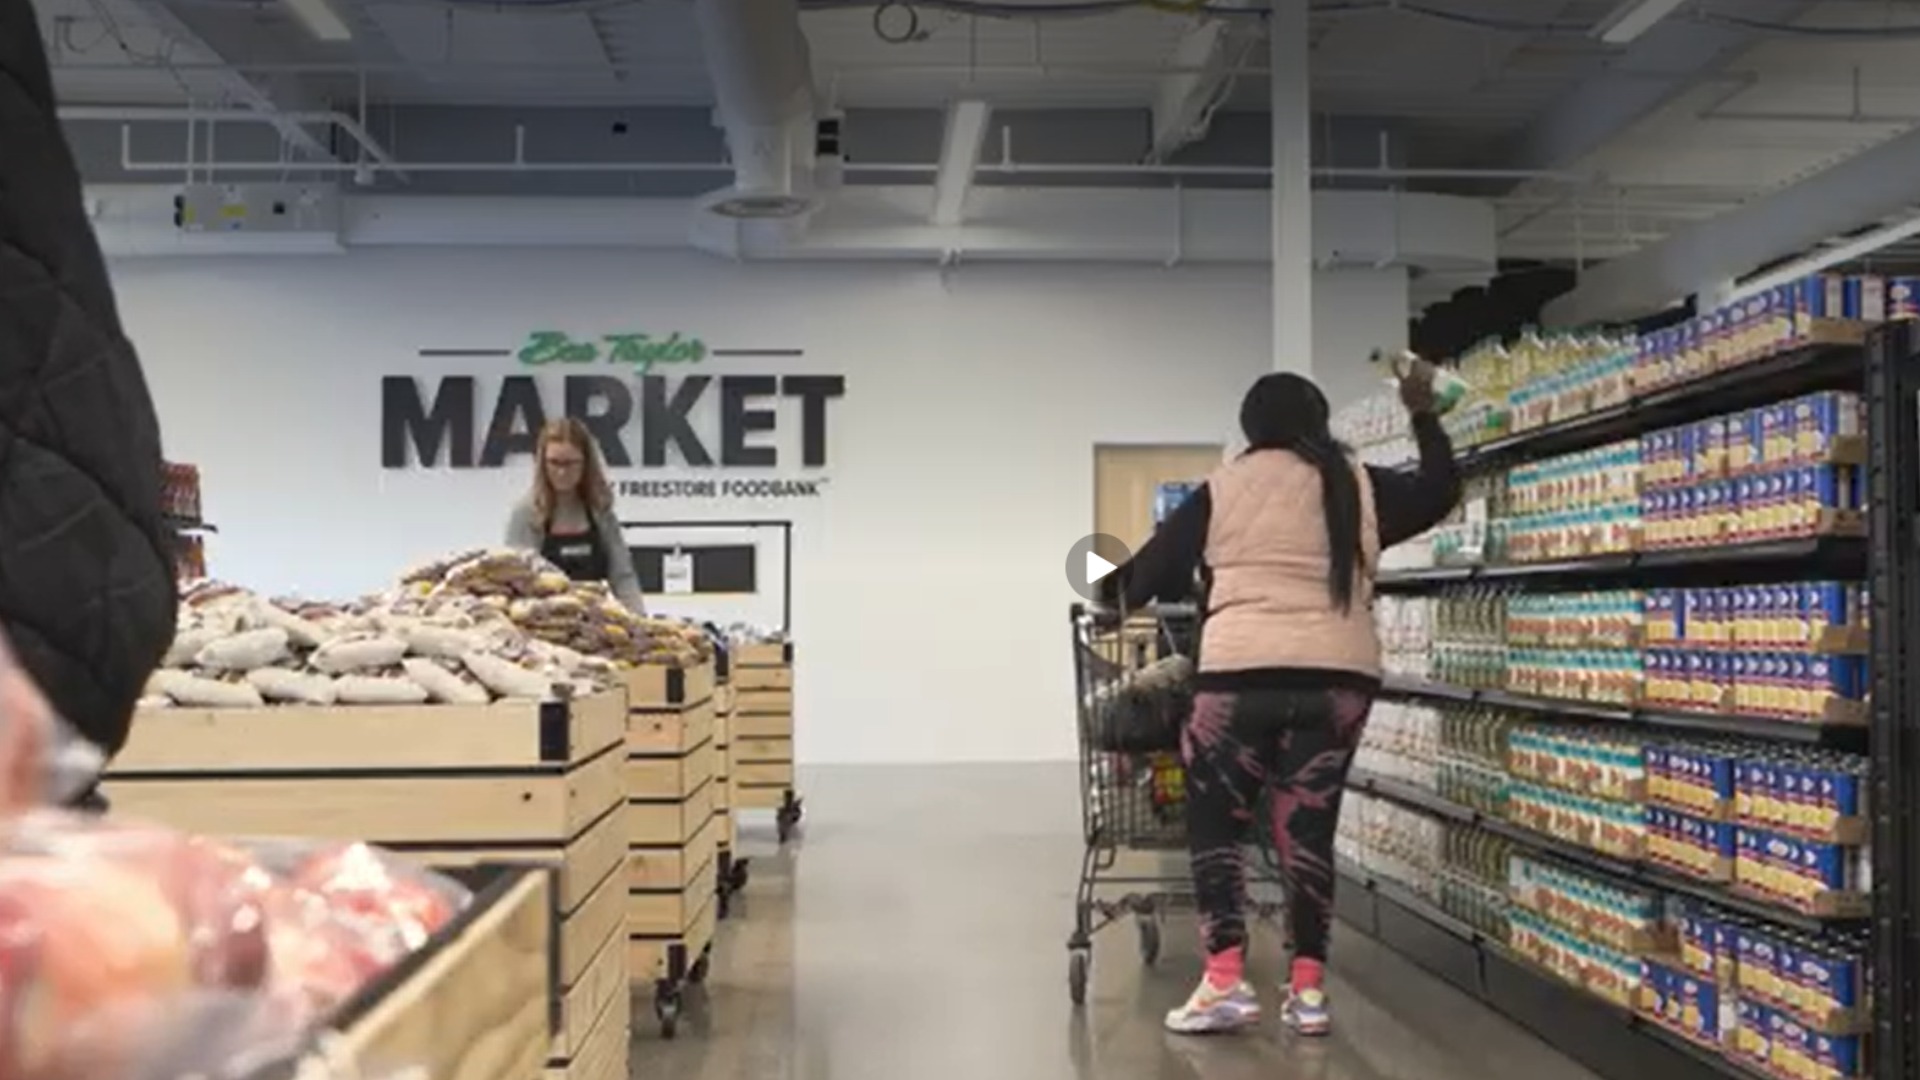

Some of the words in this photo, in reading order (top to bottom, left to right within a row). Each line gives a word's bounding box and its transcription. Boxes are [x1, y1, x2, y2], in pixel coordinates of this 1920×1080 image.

[603, 331, 706, 376] Taylor
[382, 375, 846, 467] MARKET
[619, 480, 716, 497] FREESTORE
[722, 480, 820, 497] FOODBANK
